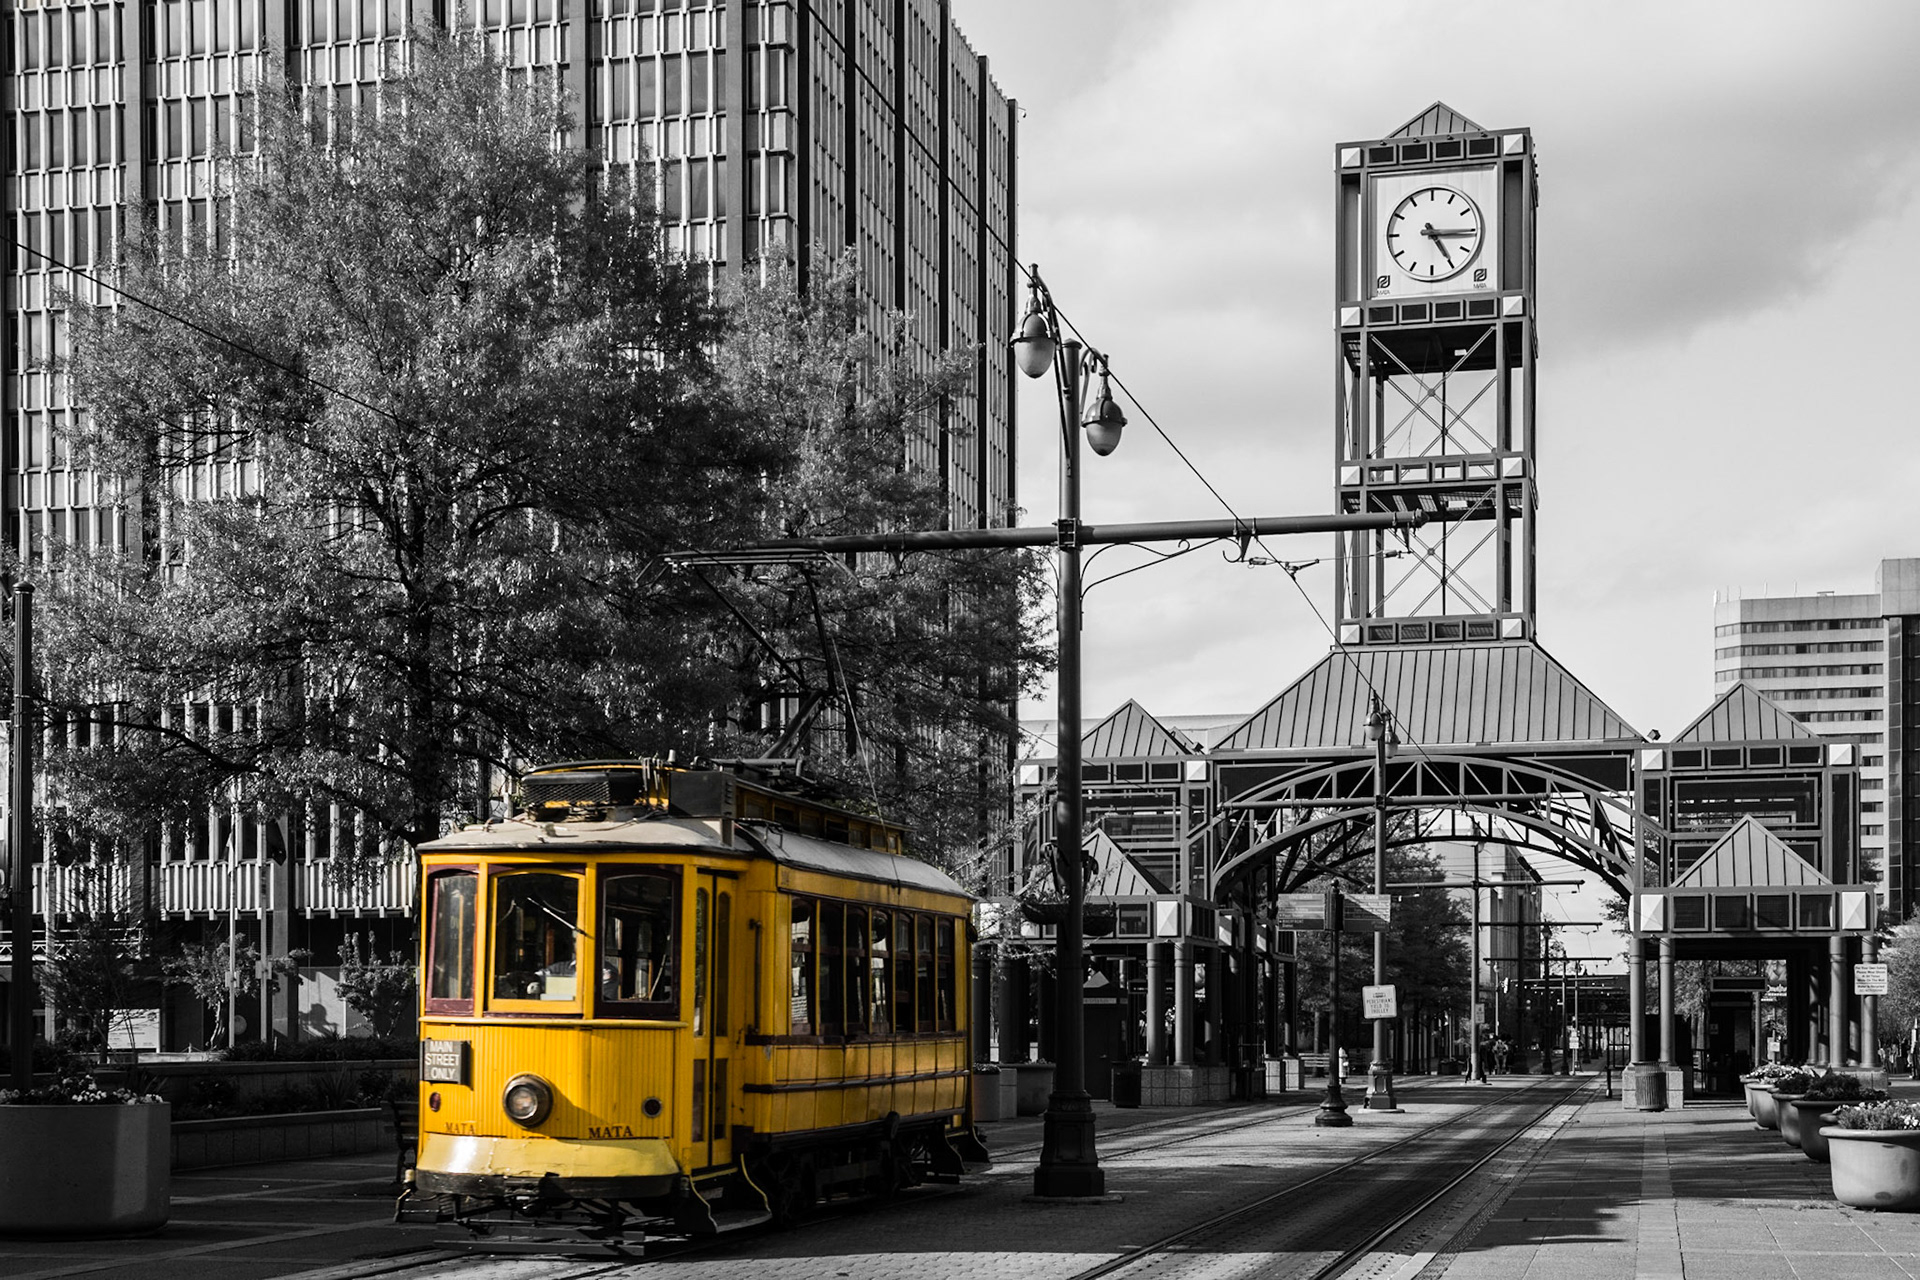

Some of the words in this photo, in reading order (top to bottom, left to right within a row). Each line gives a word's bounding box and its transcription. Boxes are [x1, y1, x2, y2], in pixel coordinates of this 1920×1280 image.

[429, 1041, 453, 1053] MAIN
[424, 1053, 460, 1066] STREET
[431, 1067, 456, 1080] ONLY
[445, 1122, 476, 1135] MATA
[588, 1125, 634, 1139] MATA
